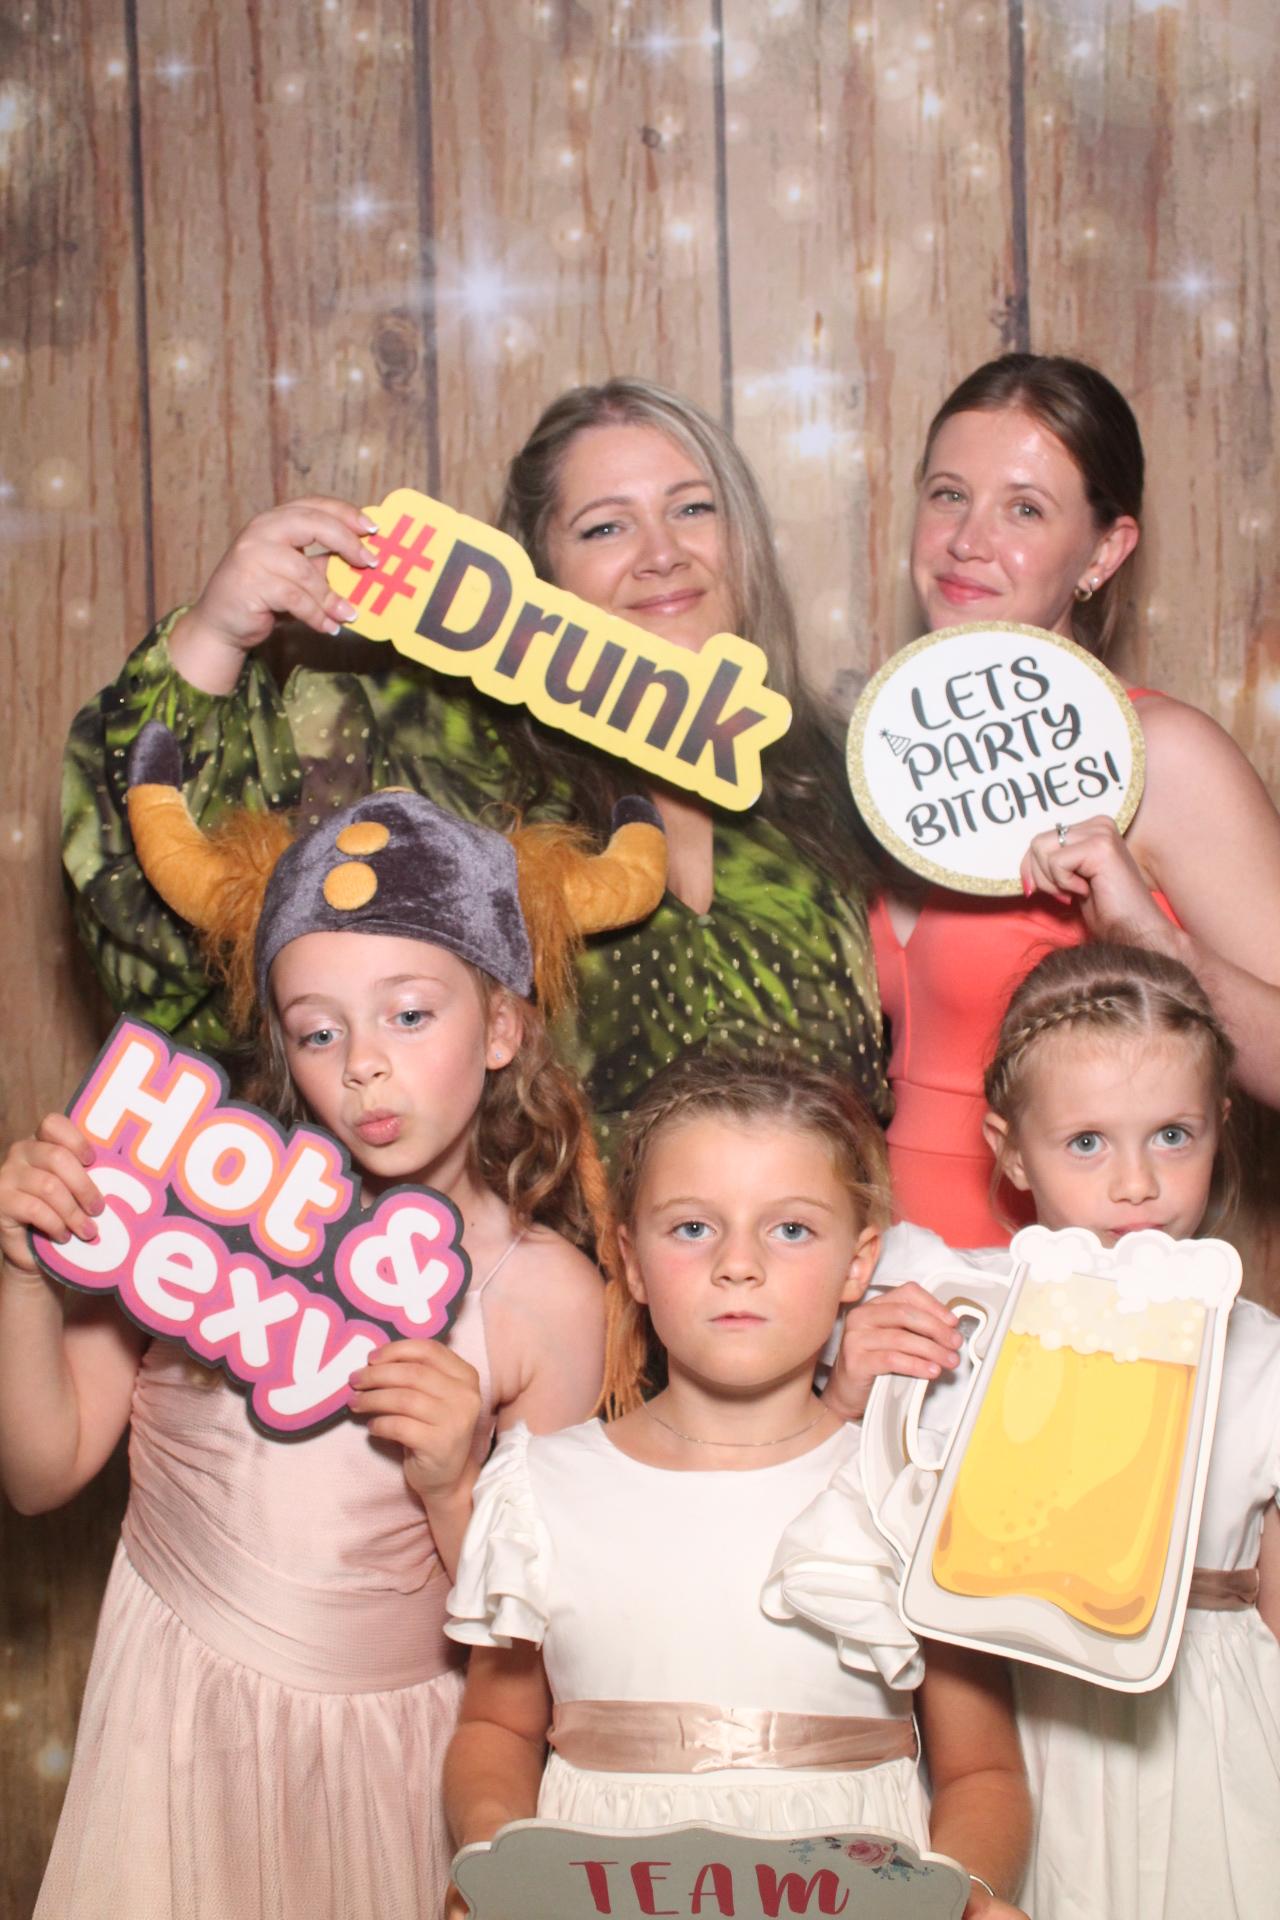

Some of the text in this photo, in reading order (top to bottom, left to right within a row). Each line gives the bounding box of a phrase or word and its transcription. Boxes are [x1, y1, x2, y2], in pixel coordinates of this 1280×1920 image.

[349, 513, 767, 787] #Drunk
[910, 655, 1050, 730] LETS
[901, 703, 1082, 792] PARTY
[905, 750, 1124, 847] BITCHES!
[83, 1039, 449, 1325] Hot &
[50, 1166, 377, 1416] Sexy
